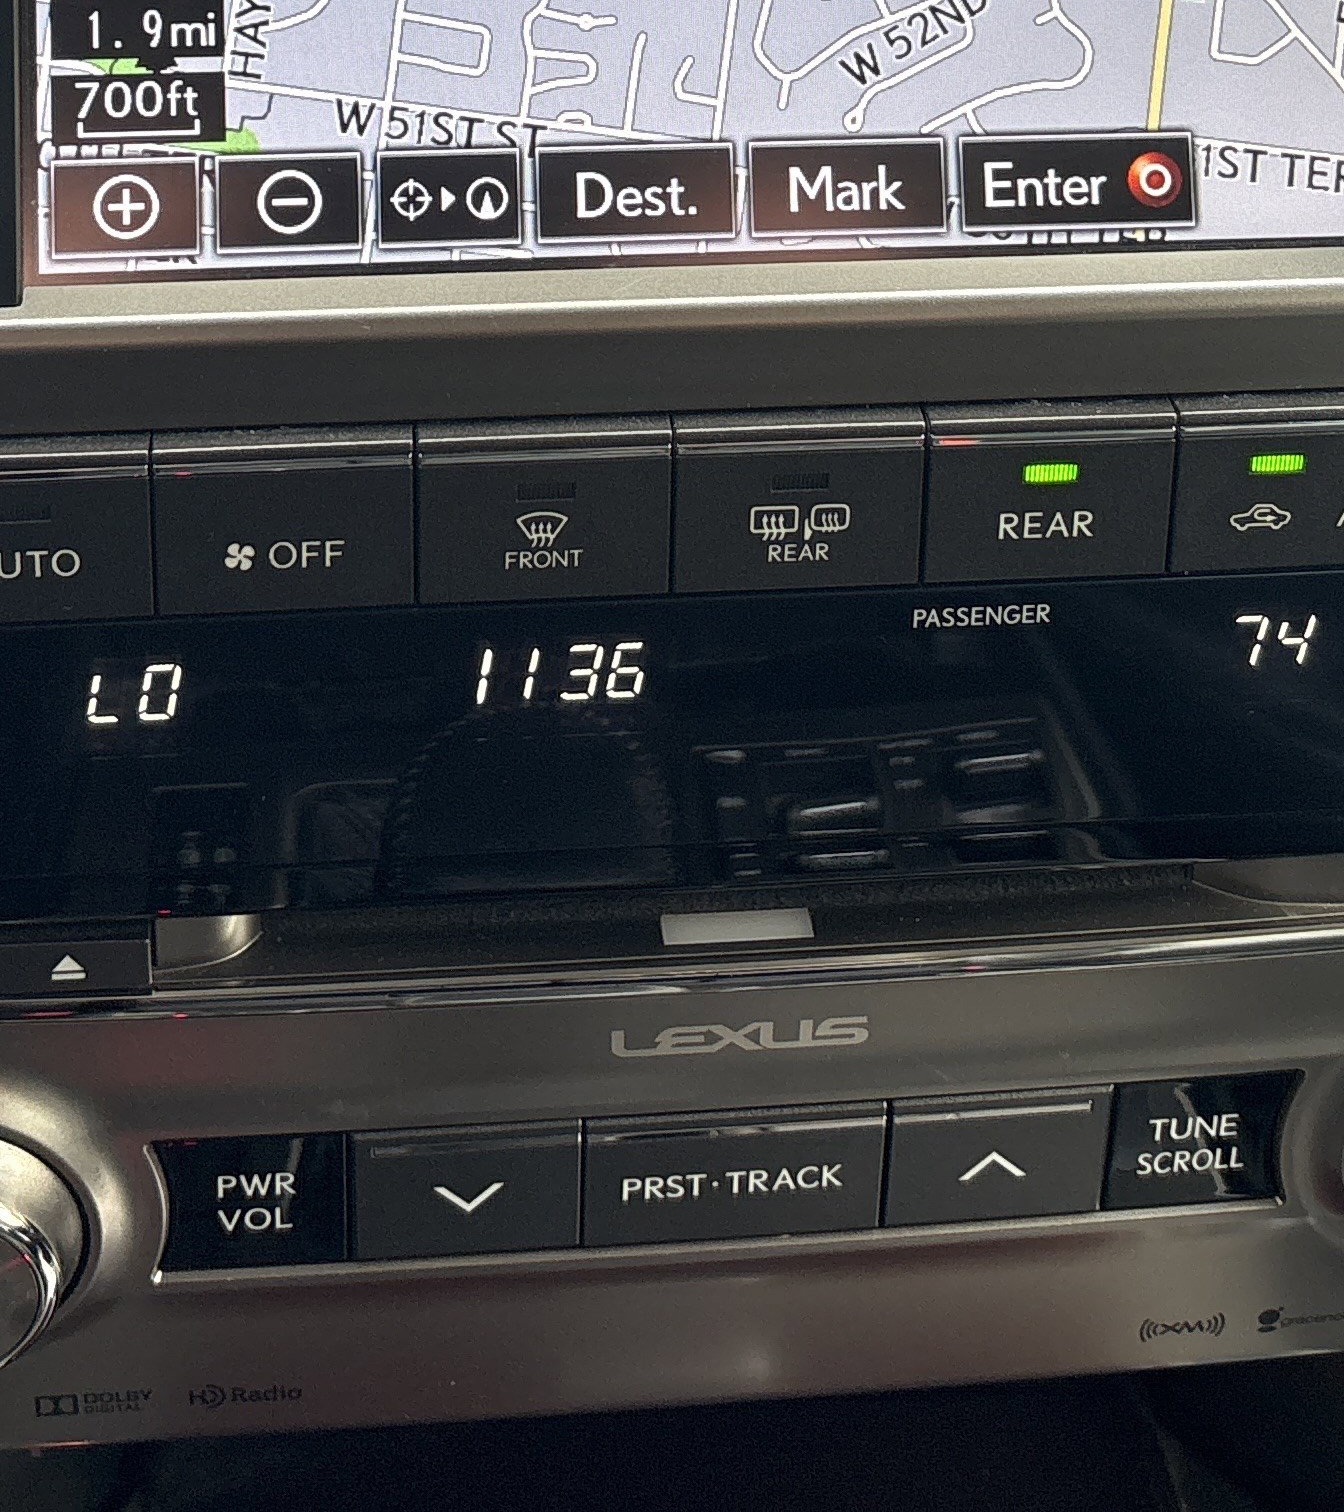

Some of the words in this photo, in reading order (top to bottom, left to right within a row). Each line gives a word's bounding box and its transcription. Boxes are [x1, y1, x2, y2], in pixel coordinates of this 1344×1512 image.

[838, 42, 882, 86] W
[74, 80, 199, 119] 700ft
[336, 98, 377, 137] W
[384, 106, 486, 149] 51ST
[497, 120, 549, 159] ST
[576, 170, 698, 220] Dest.
[788, 163, 907, 213] Mark
[983, 160, 1107, 208] Enter
[996, 509, 1095, 541] REAR
[267, 539, 346, 570] OFF
[503, 545, 585, 572] FRONT
[765, 541, 830, 564] REAR
[911, 603, 1052, 629] PASSENGER
[1234, 613, 1316, 666] 74
[610, 1014, 870, 1058] LEXUS
[1148, 1111, 1240, 1143] TUNE
[1134, 1144, 1247, 1176] SCROLL
[215, 1171, 297, 1203] PWR
[215, 1203, 294, 1233] VOL
[83, 1389, 154, 1404] DOLBY
[229, 1385, 303, 1403] Radio
